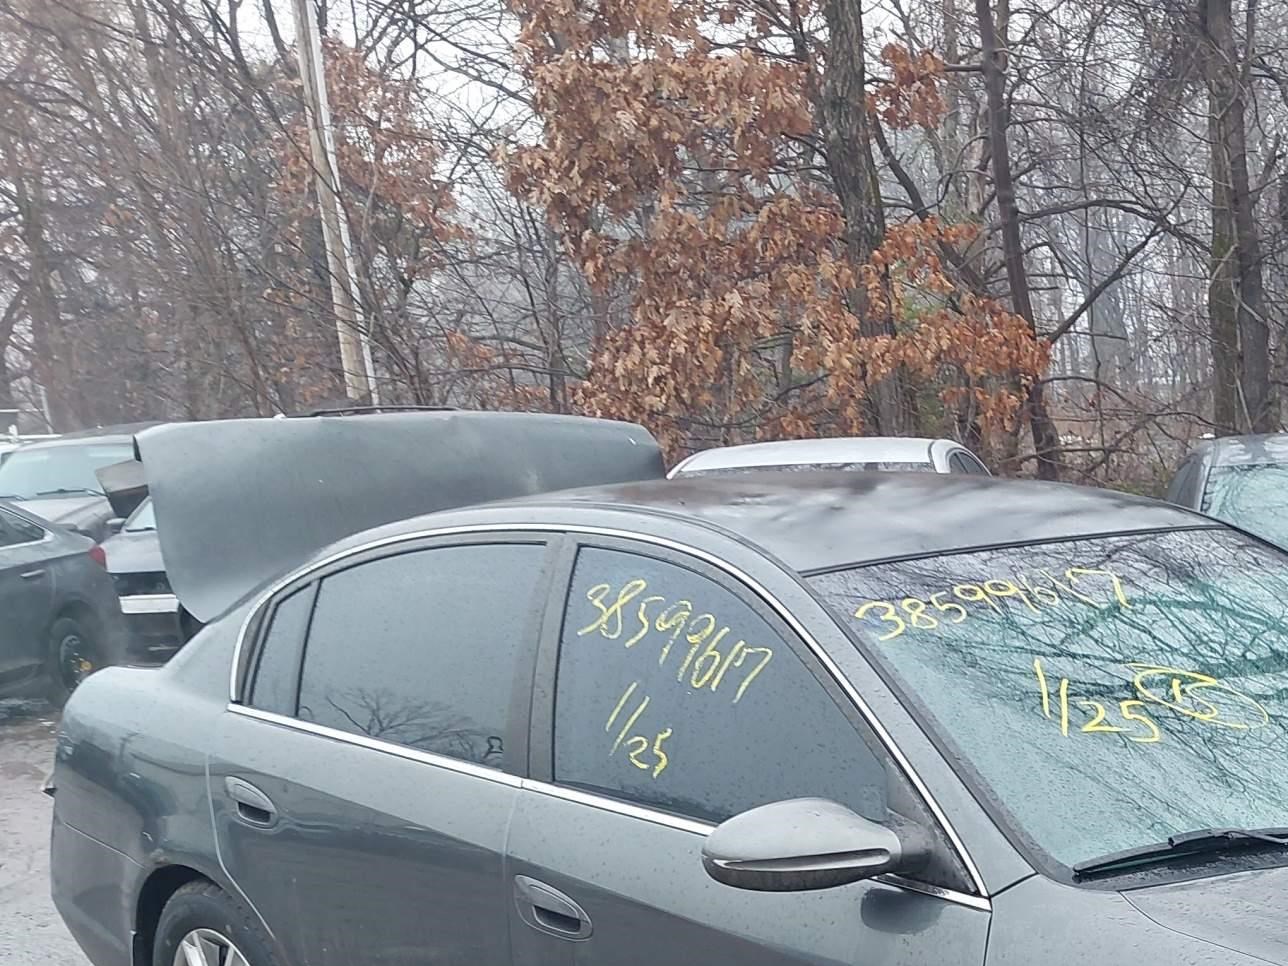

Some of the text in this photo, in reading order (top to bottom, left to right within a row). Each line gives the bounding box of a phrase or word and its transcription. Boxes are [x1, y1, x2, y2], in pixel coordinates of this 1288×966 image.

[577, 578, 773, 704] 38599617
[854, 567, 1134, 641] 38599617
[605, 681, 673, 779] 1/25
[1033, 657, 1161, 743] 1/25
